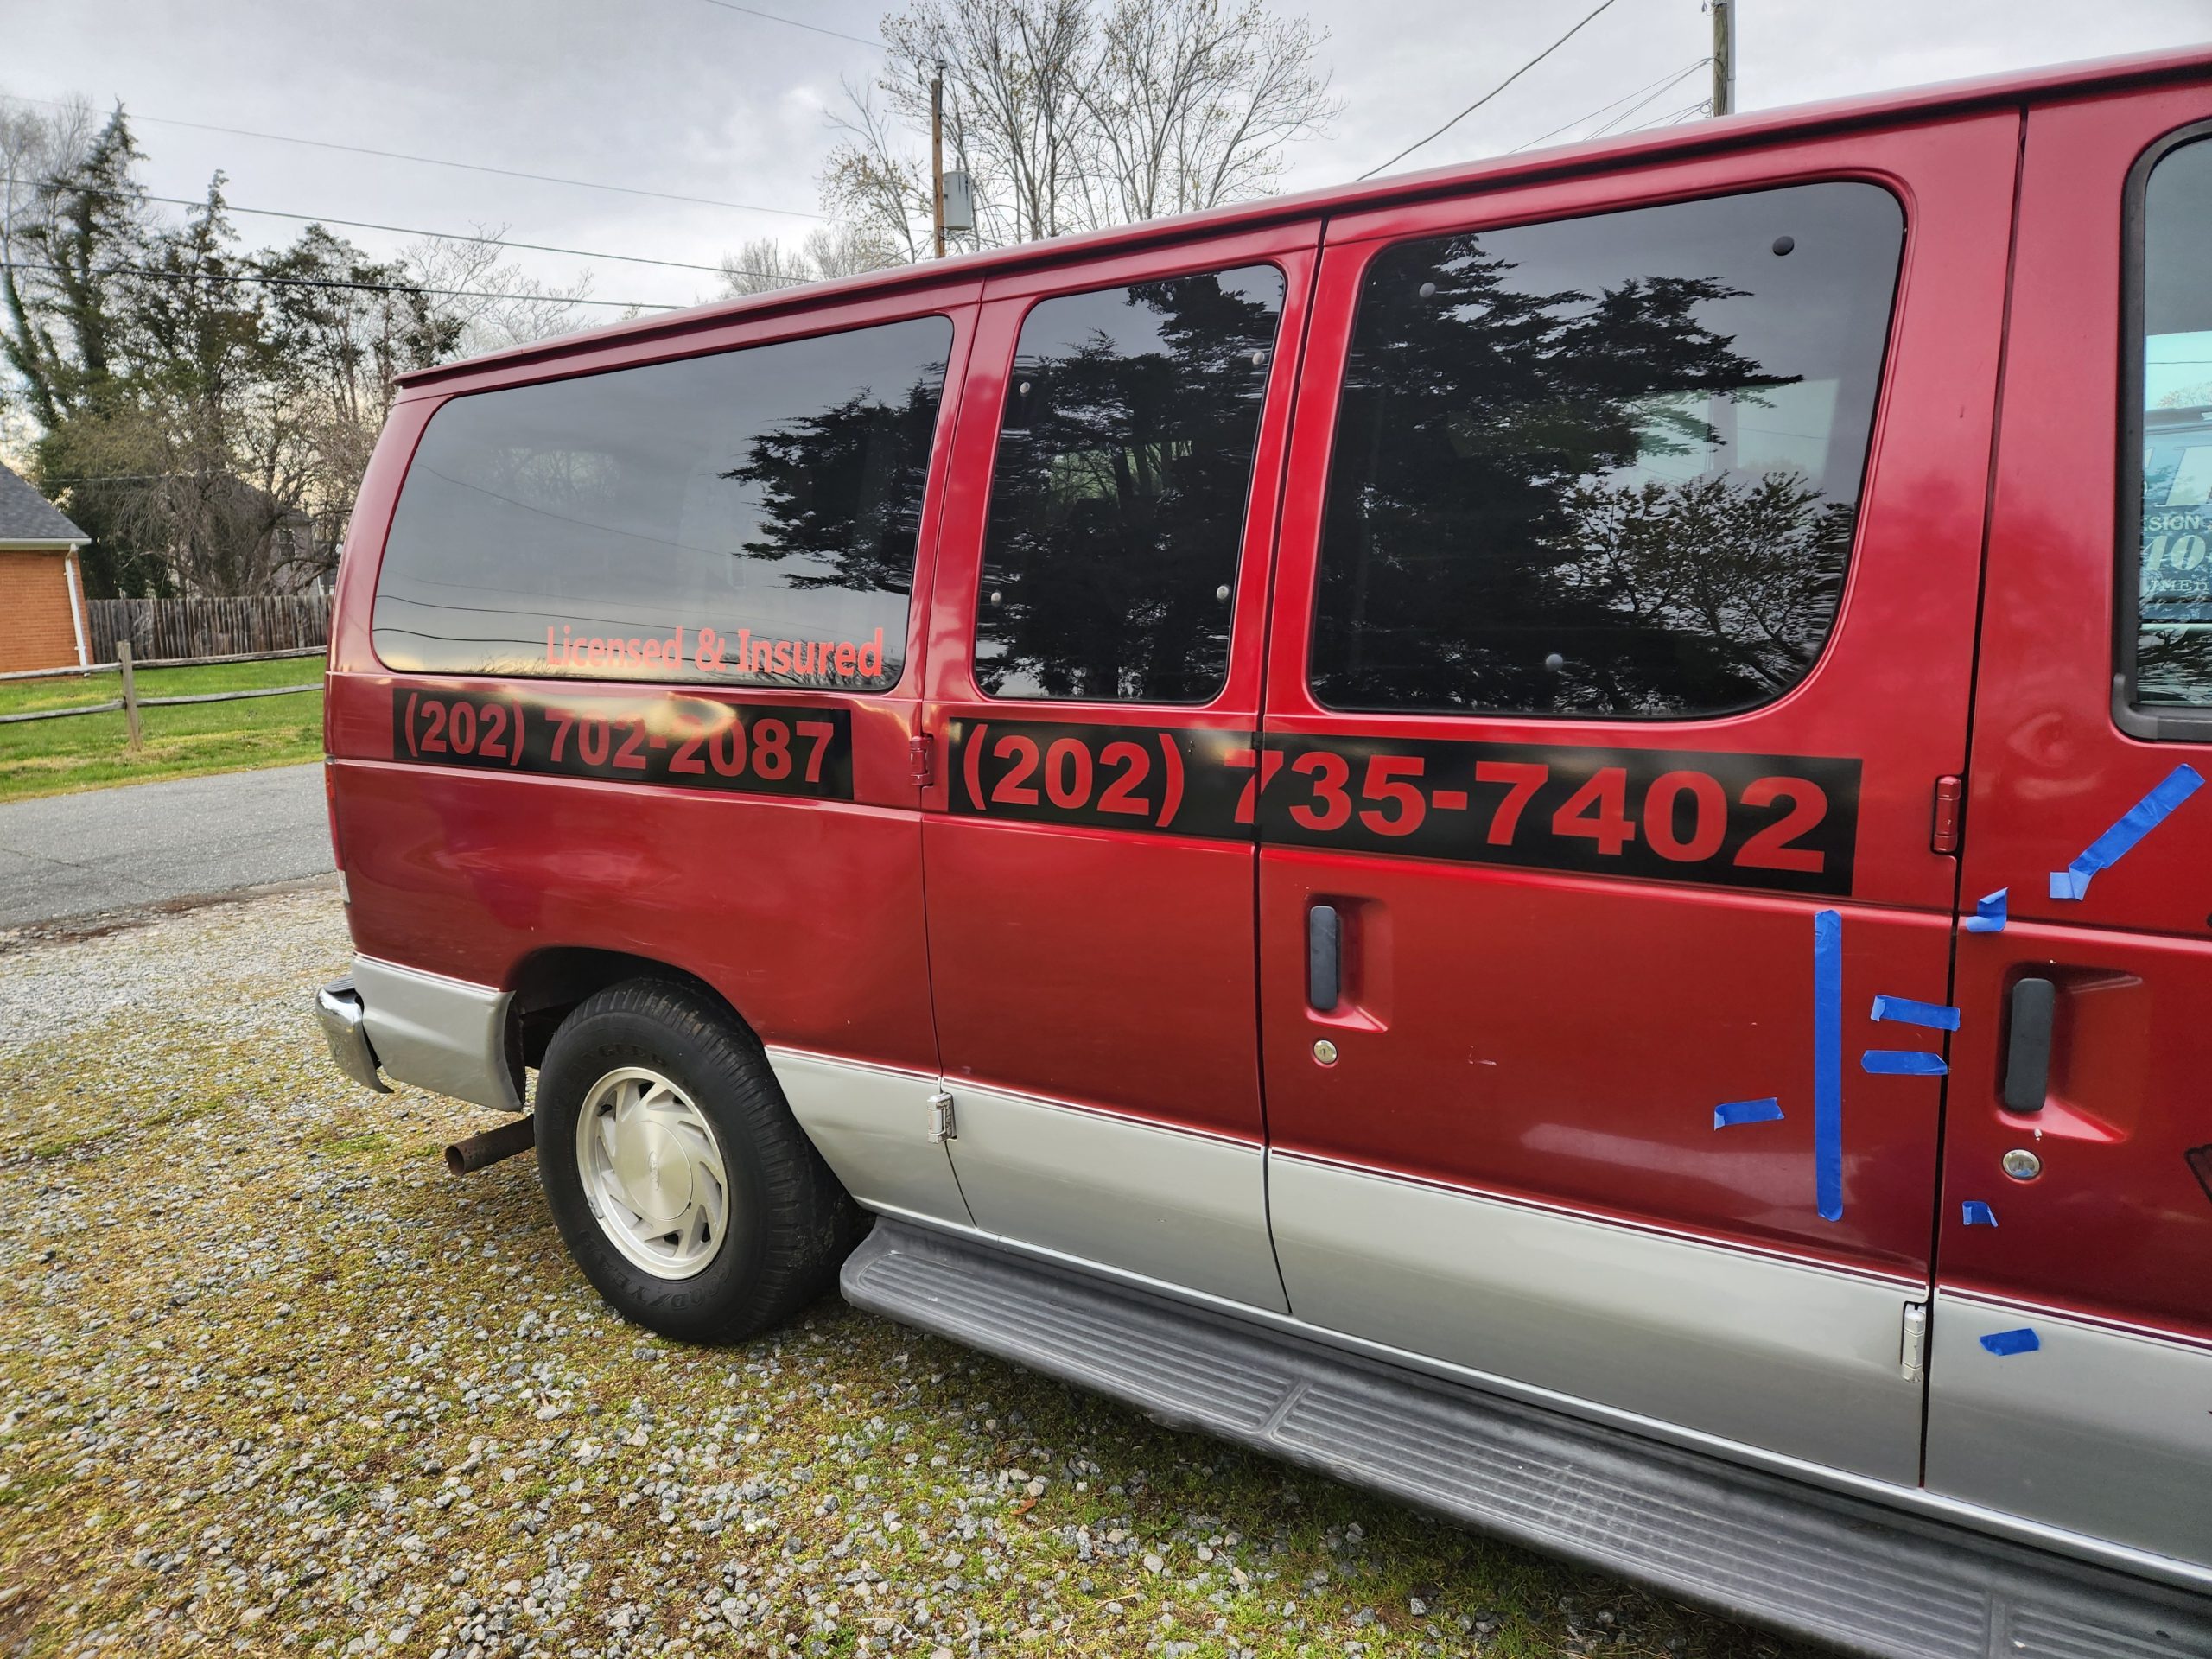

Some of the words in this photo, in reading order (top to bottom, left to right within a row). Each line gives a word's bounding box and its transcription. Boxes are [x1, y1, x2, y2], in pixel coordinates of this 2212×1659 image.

[547, 626, 682, 671] Licensed
[696, 628, 725, 671] &
[737, 628, 884, 677] Insured
[404, 692, 525, 766] (202)
[545, 707, 834, 783] 702-2087
[963, 723, 1185, 828] (202)
[1224, 749, 1827, 873] 735-7402
